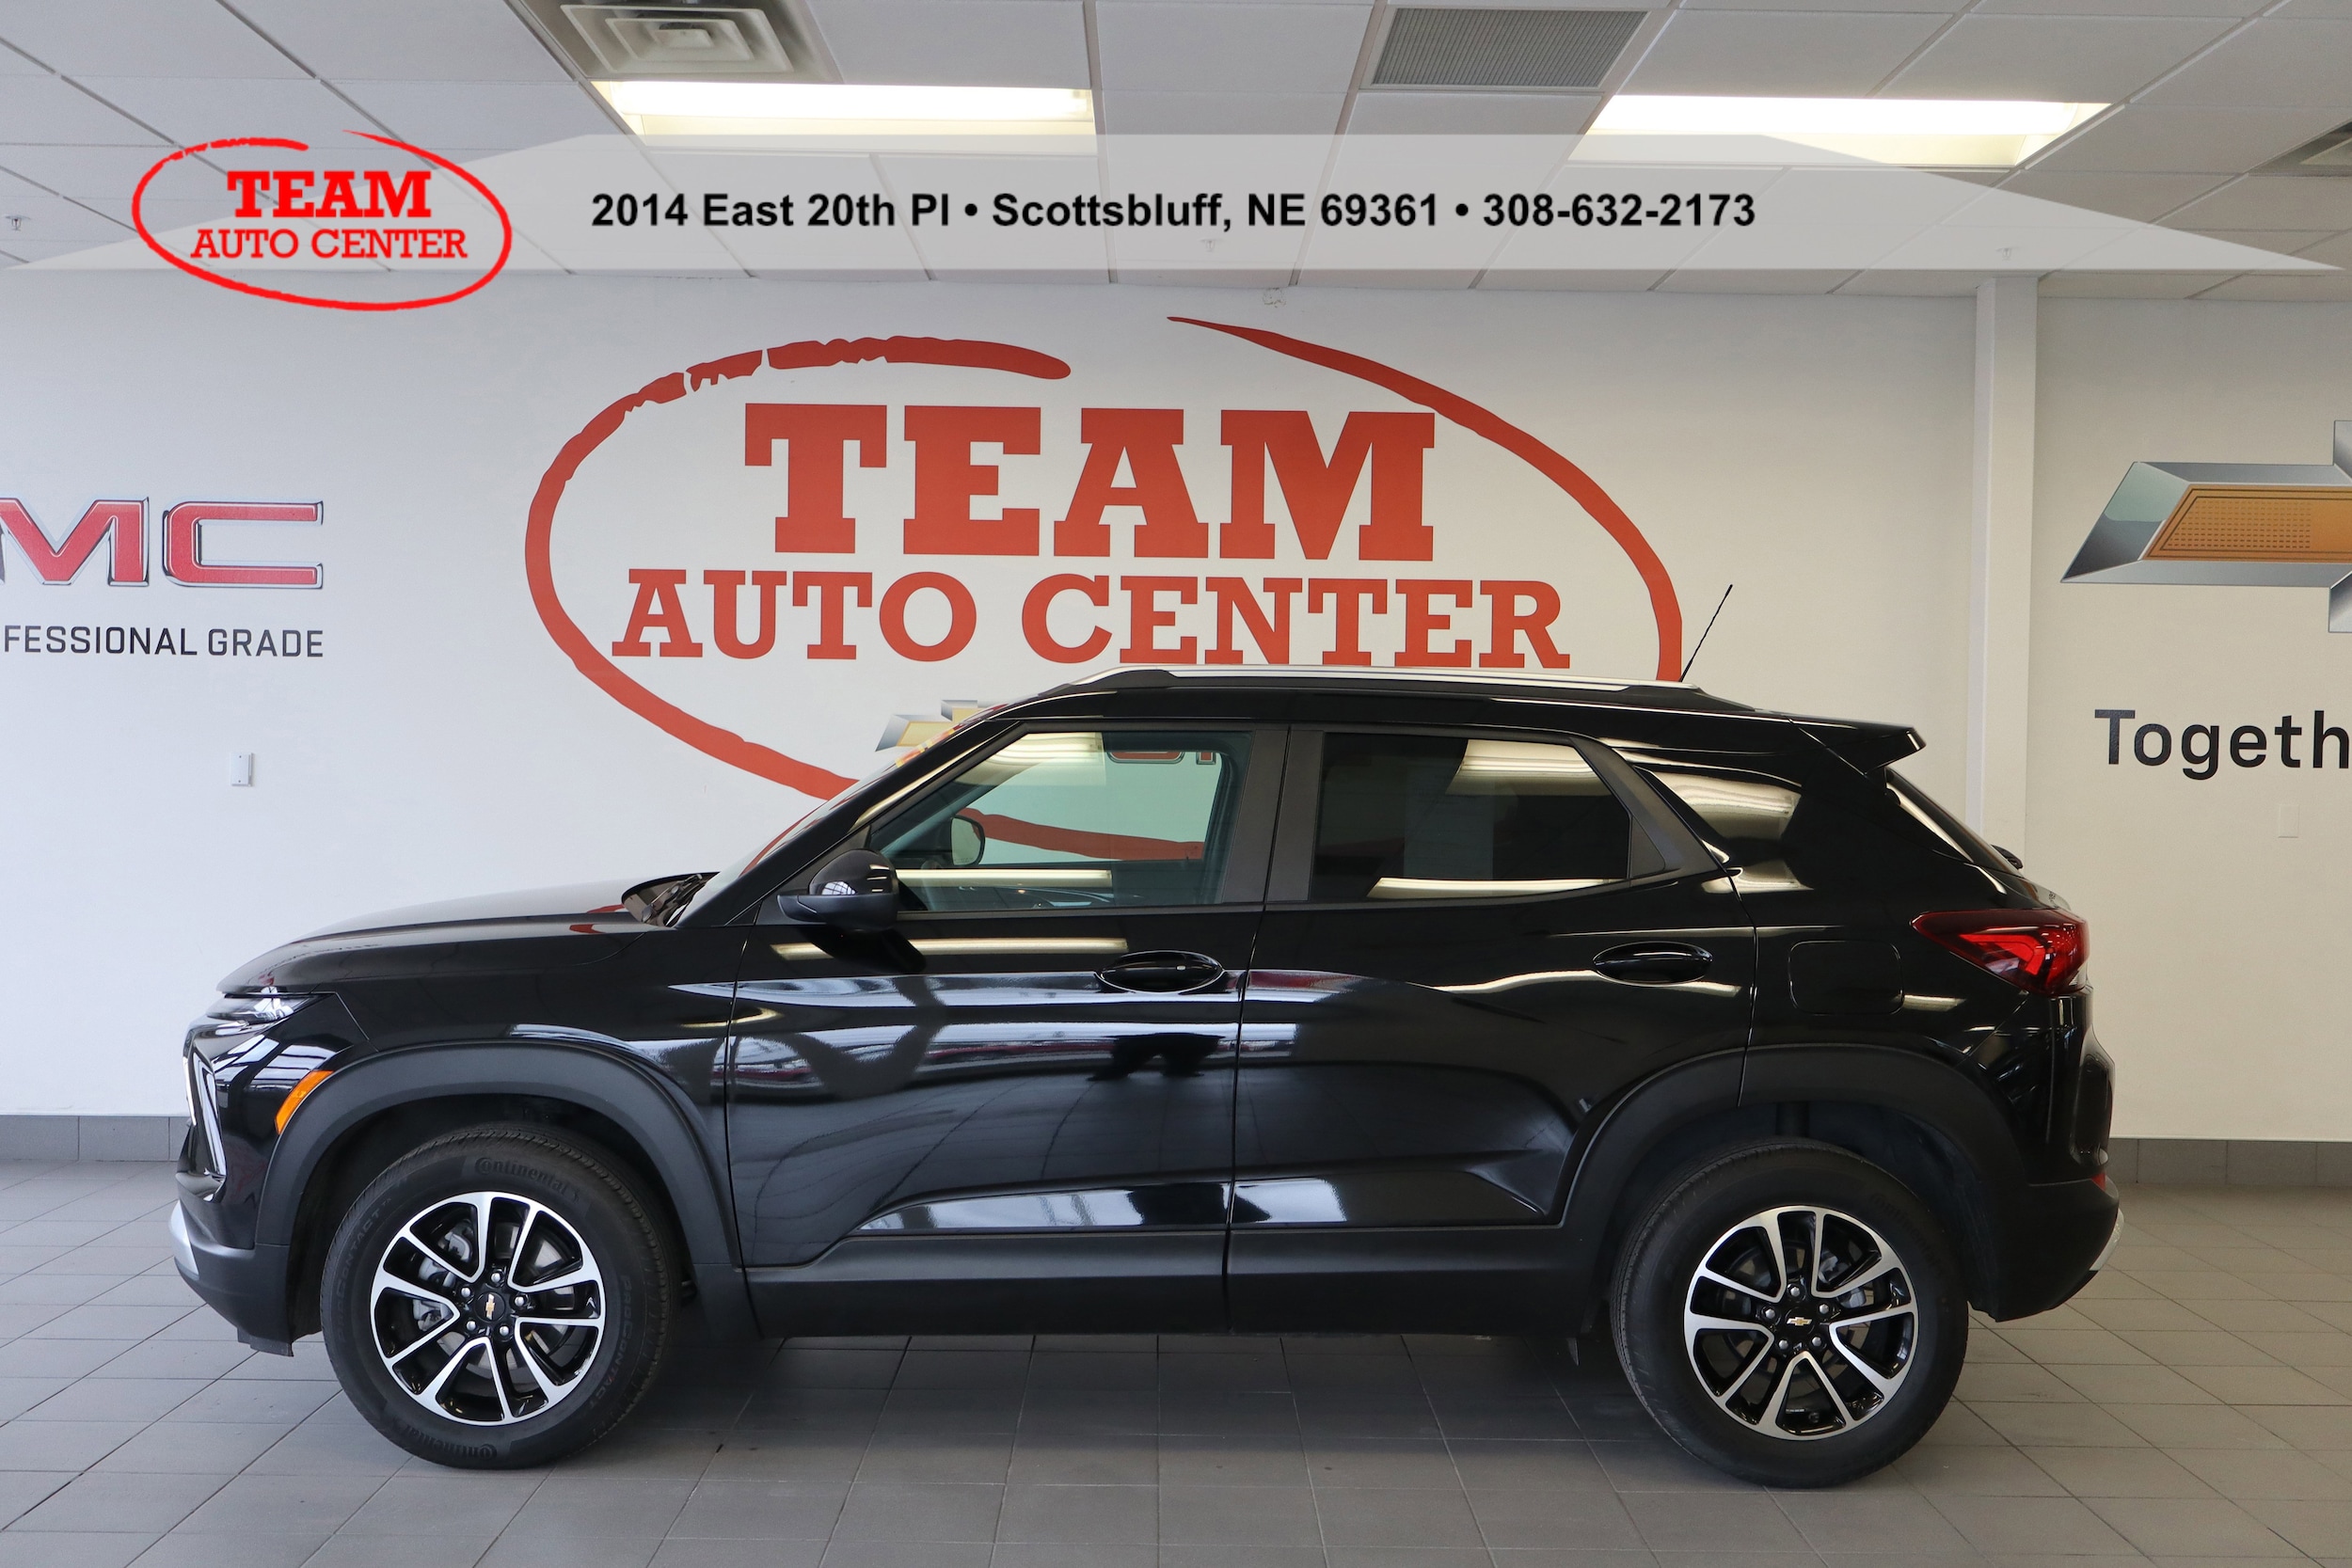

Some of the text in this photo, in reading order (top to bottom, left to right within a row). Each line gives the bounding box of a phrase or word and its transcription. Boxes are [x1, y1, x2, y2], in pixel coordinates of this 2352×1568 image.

[745, 403, 1436, 562] TEAM
[4, 625, 324, 657] FESSIONAL GRADE
[612, 568, 1571, 670] AUTO CENTER
[2094, 709, 2351, 781] Togeth
[474, 1156, 571, 1196] Continental
